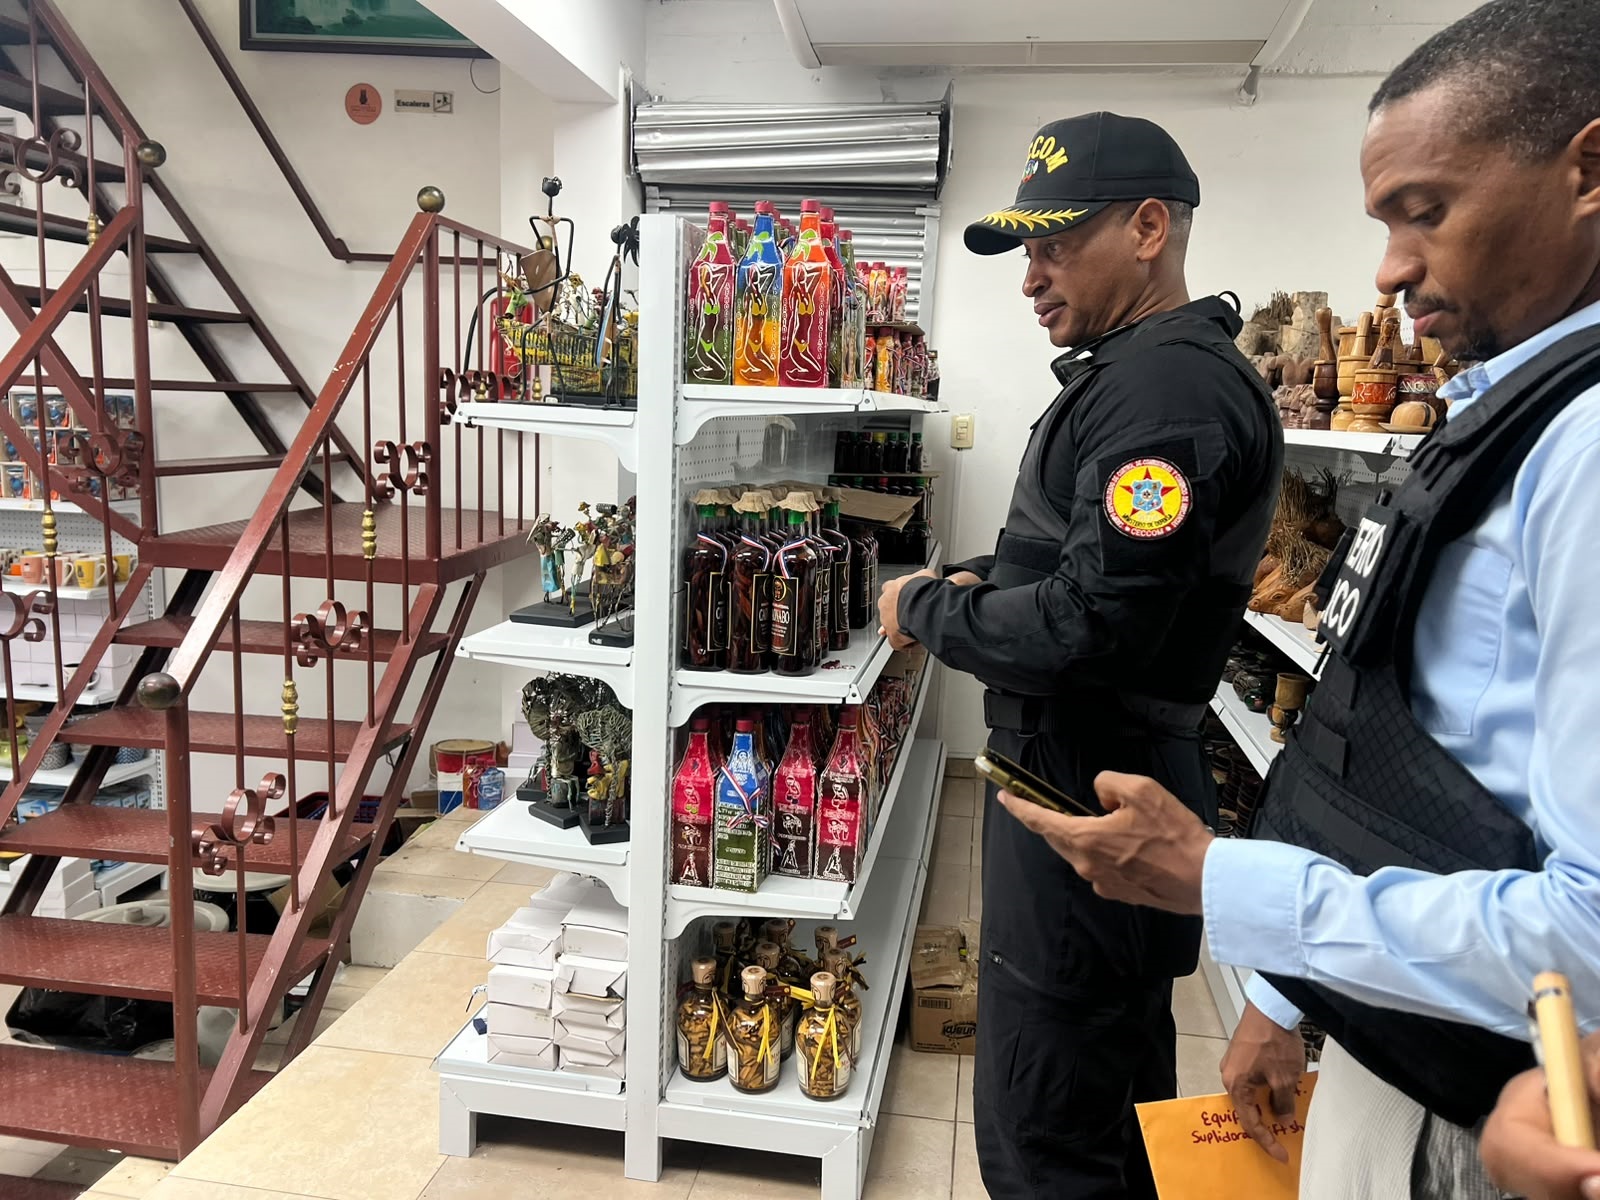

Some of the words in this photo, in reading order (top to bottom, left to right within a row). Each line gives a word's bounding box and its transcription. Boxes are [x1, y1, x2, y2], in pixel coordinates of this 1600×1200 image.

[396, 99, 430, 108] Escaleras
[1130, 528, 1165, 537] CECCOM
[1346, 517, 1387, 578] ERO
[1322, 578, 1360, 638] ICO
